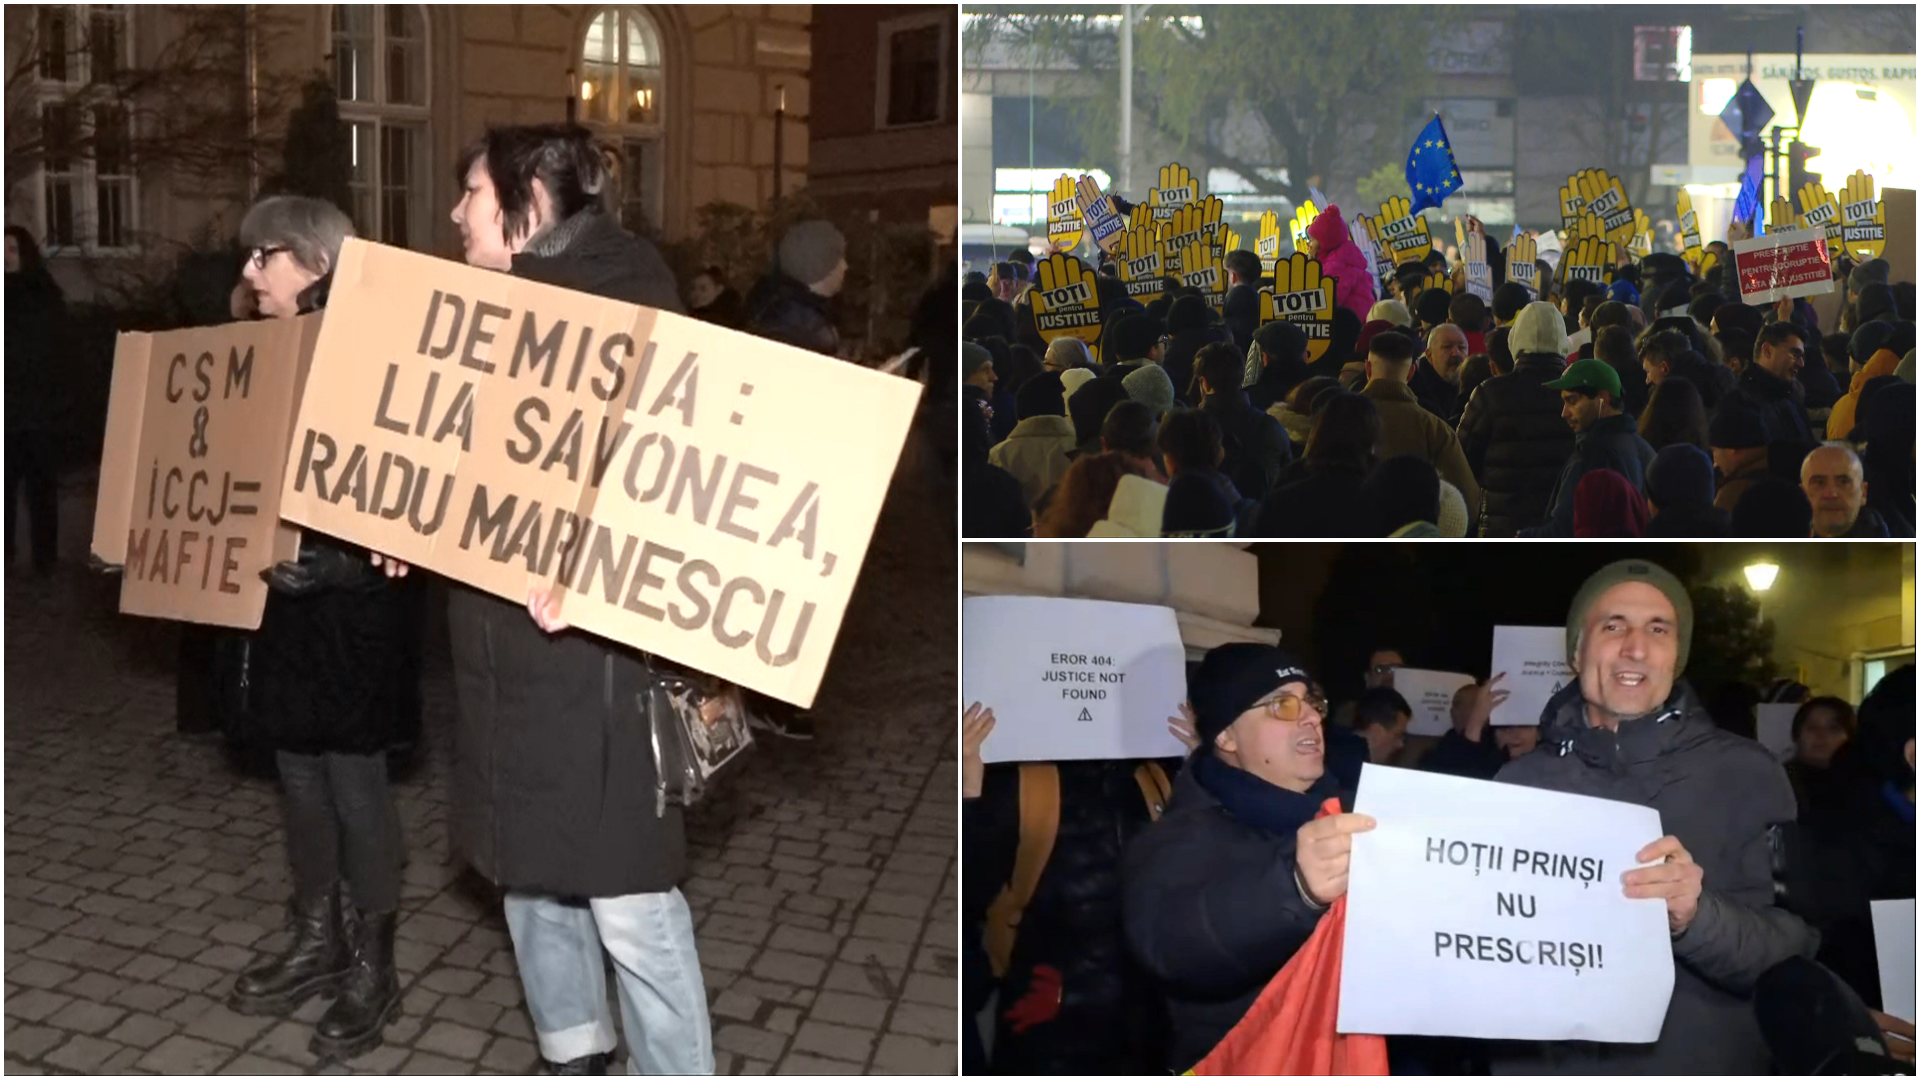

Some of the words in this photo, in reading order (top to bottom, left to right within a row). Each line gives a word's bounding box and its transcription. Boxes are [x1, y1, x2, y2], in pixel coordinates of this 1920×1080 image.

[1058, 304, 1083, 314] pentru
[1274, 290, 1322, 313] TOȚI
[1288, 313, 1314, 322] pentru
[166, 345, 255, 403] CSM
[417, 289, 699, 427] DEMISIA
[189, 405, 210, 459] &
[374, 363, 474, 453] LIA
[506, 396, 838, 578] SAVONEA,
[123, 528, 248, 595] MAFIE
[294, 428, 456, 536] RADU
[458, 483, 817, 668] MARINESCU
[1042, 671, 1095, 683] JUSTICE
[1100, 672, 1127, 684] NOT
[1051, 653, 1088, 666] EROR
[1091, 655, 1116, 667] 404:
[1062, 688, 1107, 700] FOUND
[1425, 837, 1502, 877] HOȚII
[1512, 848, 1604, 888] PRINȘI
[1496, 892, 1537, 918] NU
[1434, 932, 1604, 976] PRESCRIȘI!
